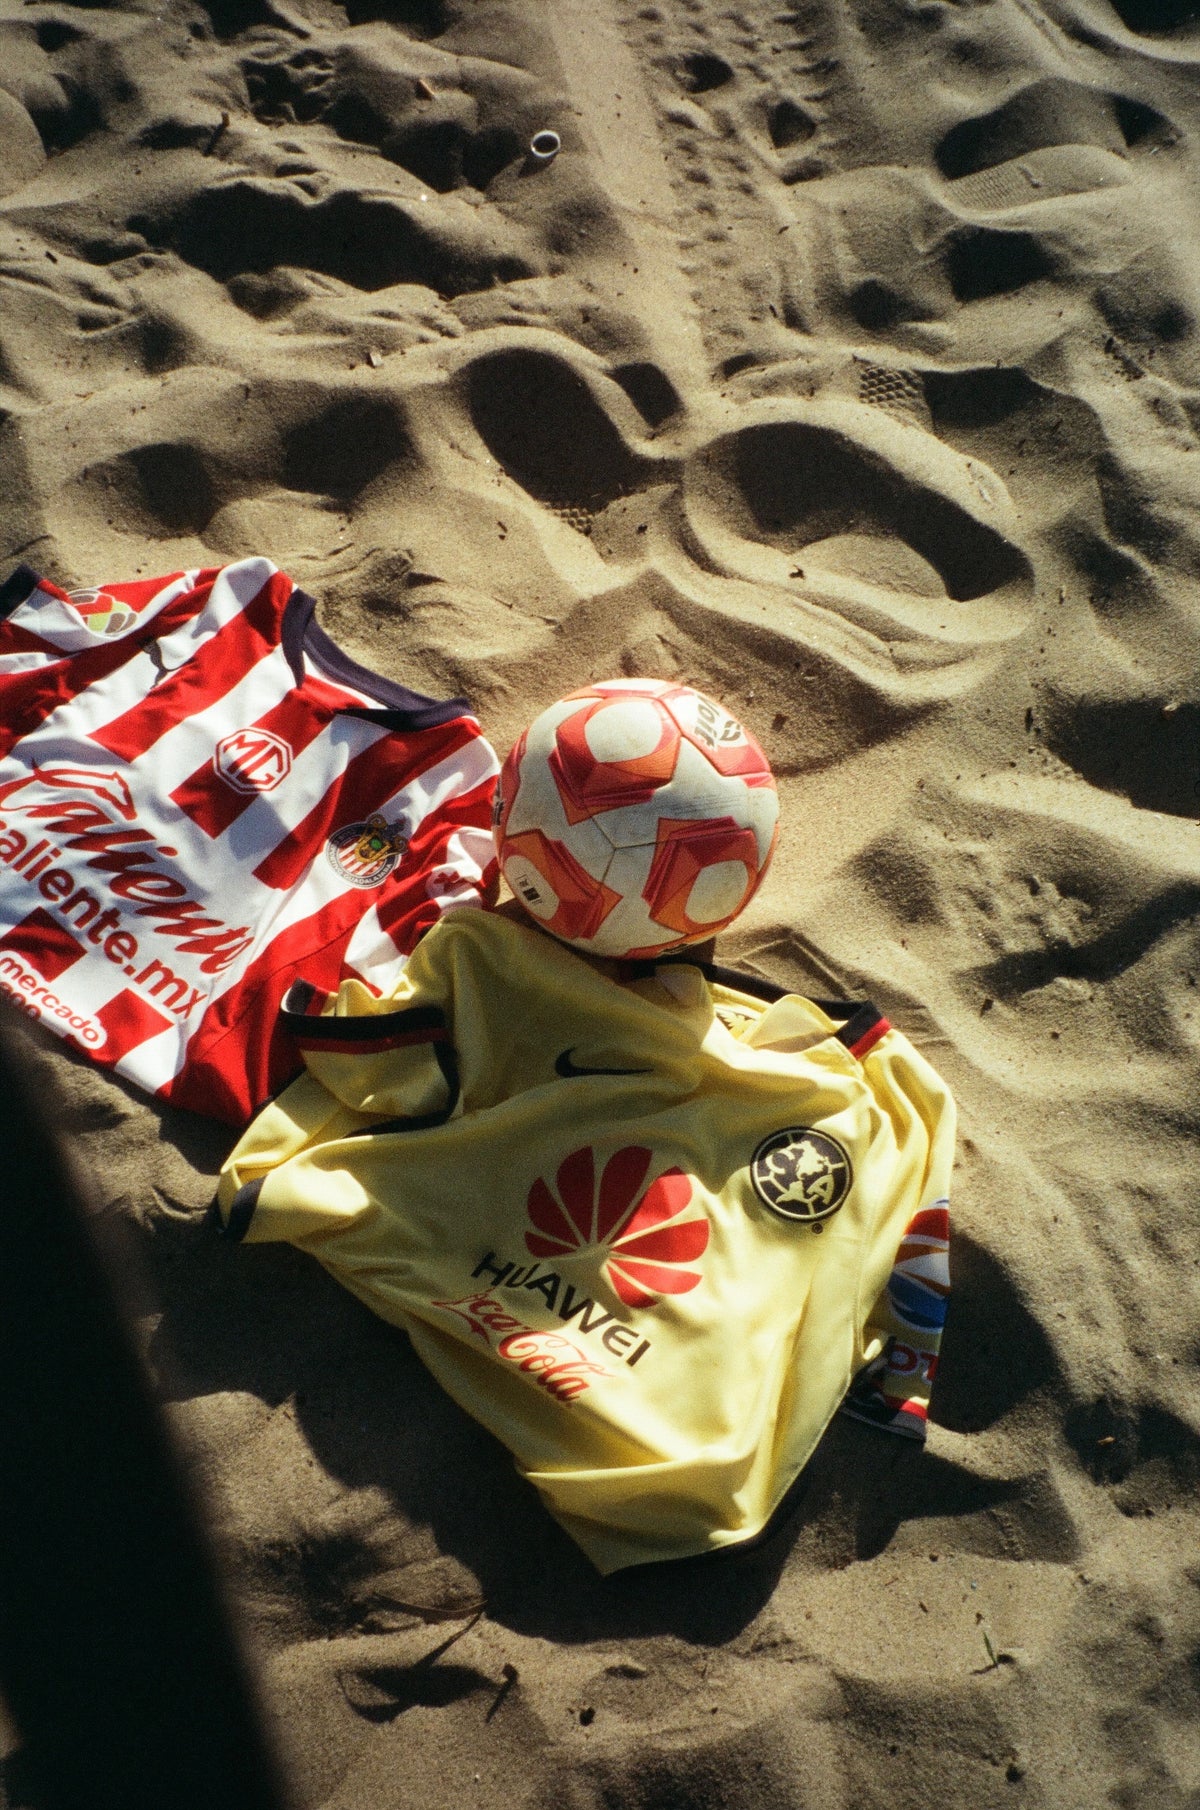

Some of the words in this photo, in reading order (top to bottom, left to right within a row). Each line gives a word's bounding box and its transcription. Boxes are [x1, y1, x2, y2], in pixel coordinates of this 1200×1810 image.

[221, 733, 285, 787] MG
[0, 820, 208, 1020] aliente.mx
[0, 957, 99, 1042] mercado
[470, 1251, 651, 1367] HUAWEI
